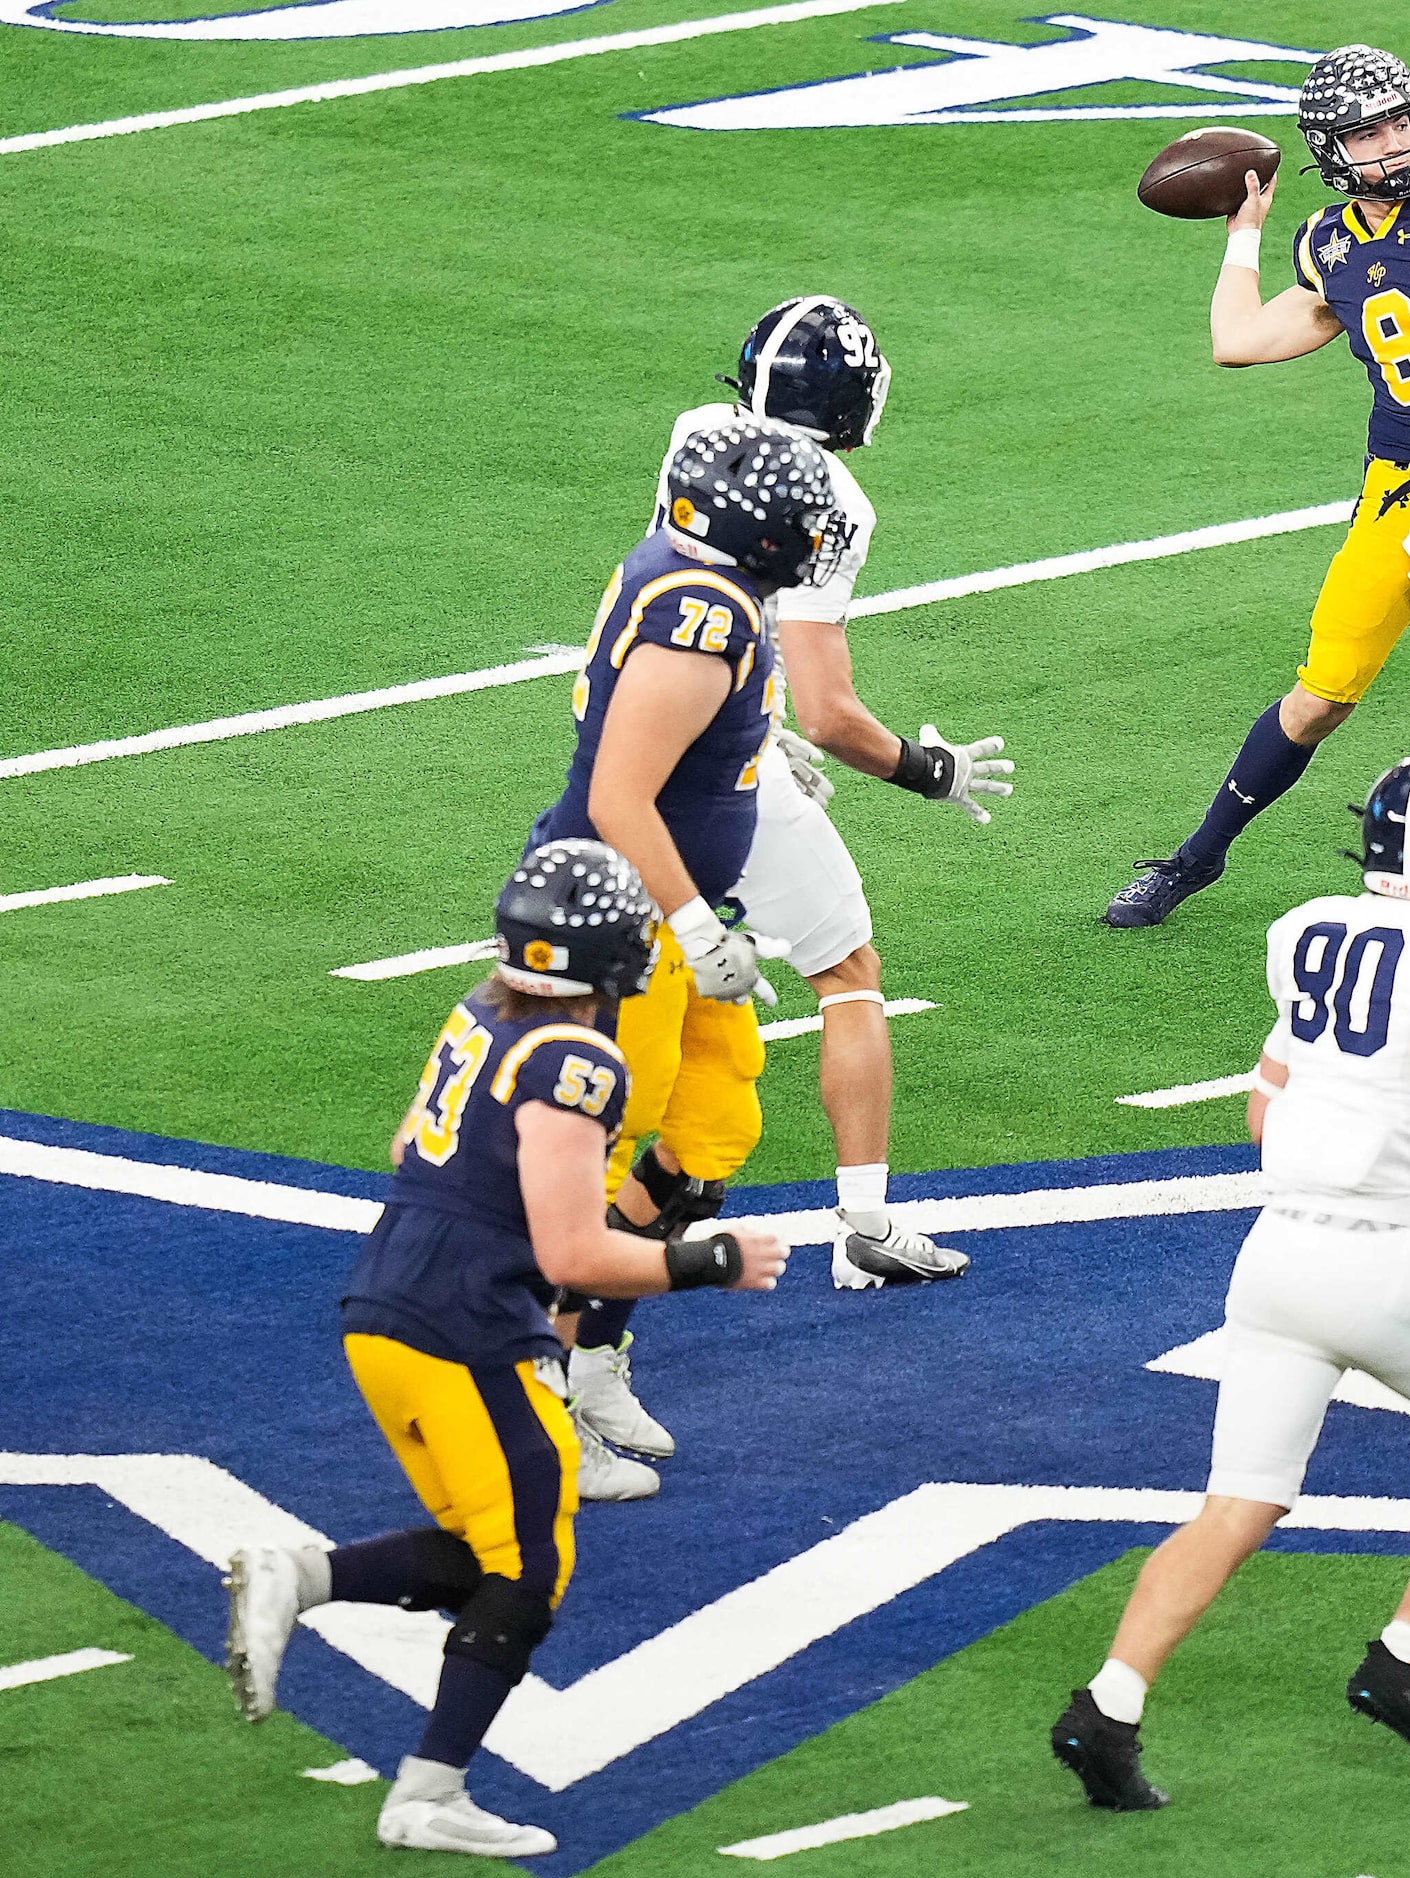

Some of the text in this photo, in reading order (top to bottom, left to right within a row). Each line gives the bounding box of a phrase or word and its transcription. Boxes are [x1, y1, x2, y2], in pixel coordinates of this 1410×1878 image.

[837, 324, 879, 368] 92
[670, 595, 734, 652] 72
[1291, 922, 1406, 1057] 90
[553, 1054, 617, 1117] 53
